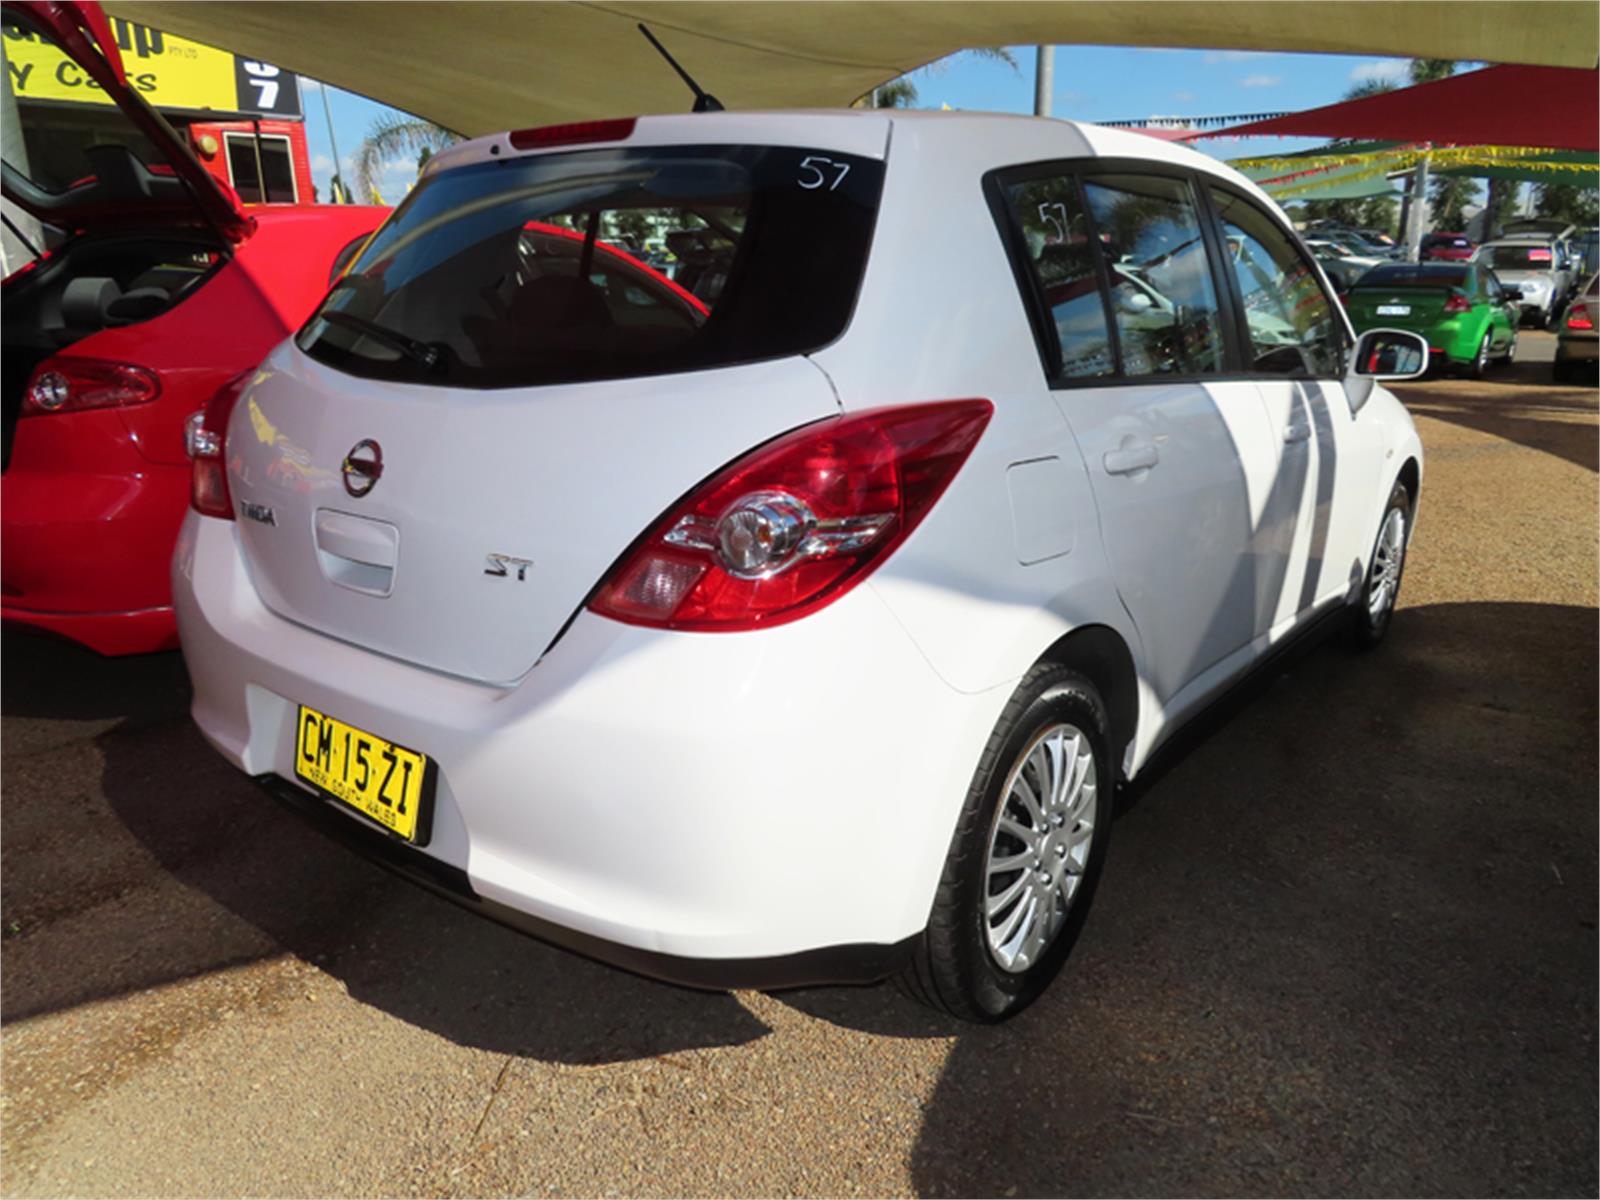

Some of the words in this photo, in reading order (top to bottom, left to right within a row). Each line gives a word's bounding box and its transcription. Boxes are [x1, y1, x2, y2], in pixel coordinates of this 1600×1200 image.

[798, 156, 850, 191] 57
[1038, 202, 1072, 243] 57
[484, 553, 534, 582] ST
